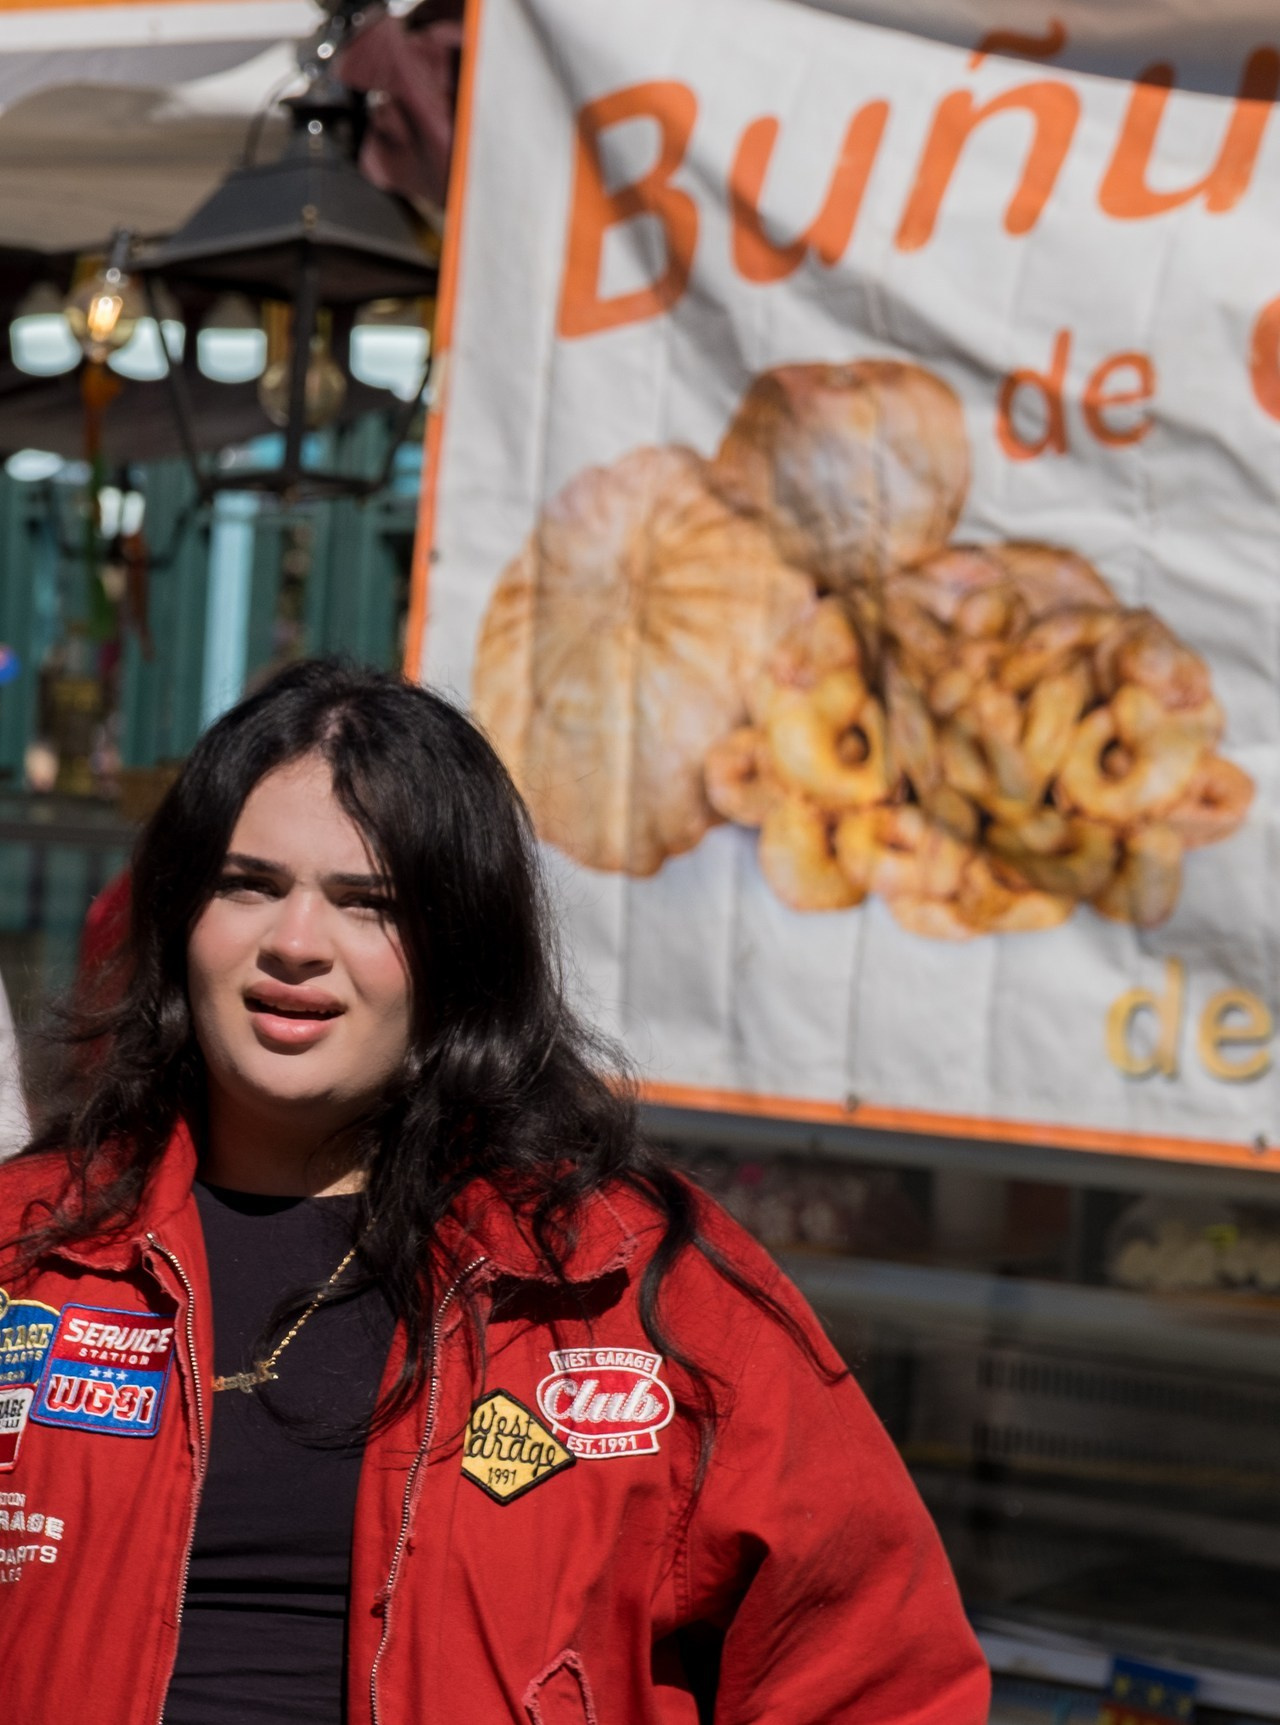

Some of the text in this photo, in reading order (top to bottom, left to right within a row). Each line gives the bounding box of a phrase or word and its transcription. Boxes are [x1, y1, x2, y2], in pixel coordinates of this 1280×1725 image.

[996, 328, 1156, 462] de
[1104, 953, 1276, 1084] de
[63, 1318, 175, 1353] SERVICE
[78, 1347, 150, 1366] STATION
[556, 1351, 655, 1373] WEST GARAGE
[45, 1374, 158, 1424] WG91
[543, 1378, 664, 1424] Club
[471, 1402, 534, 1440] West
[464, 1434, 555, 1478] arage
[488, 1467, 517, 1487] 1991
